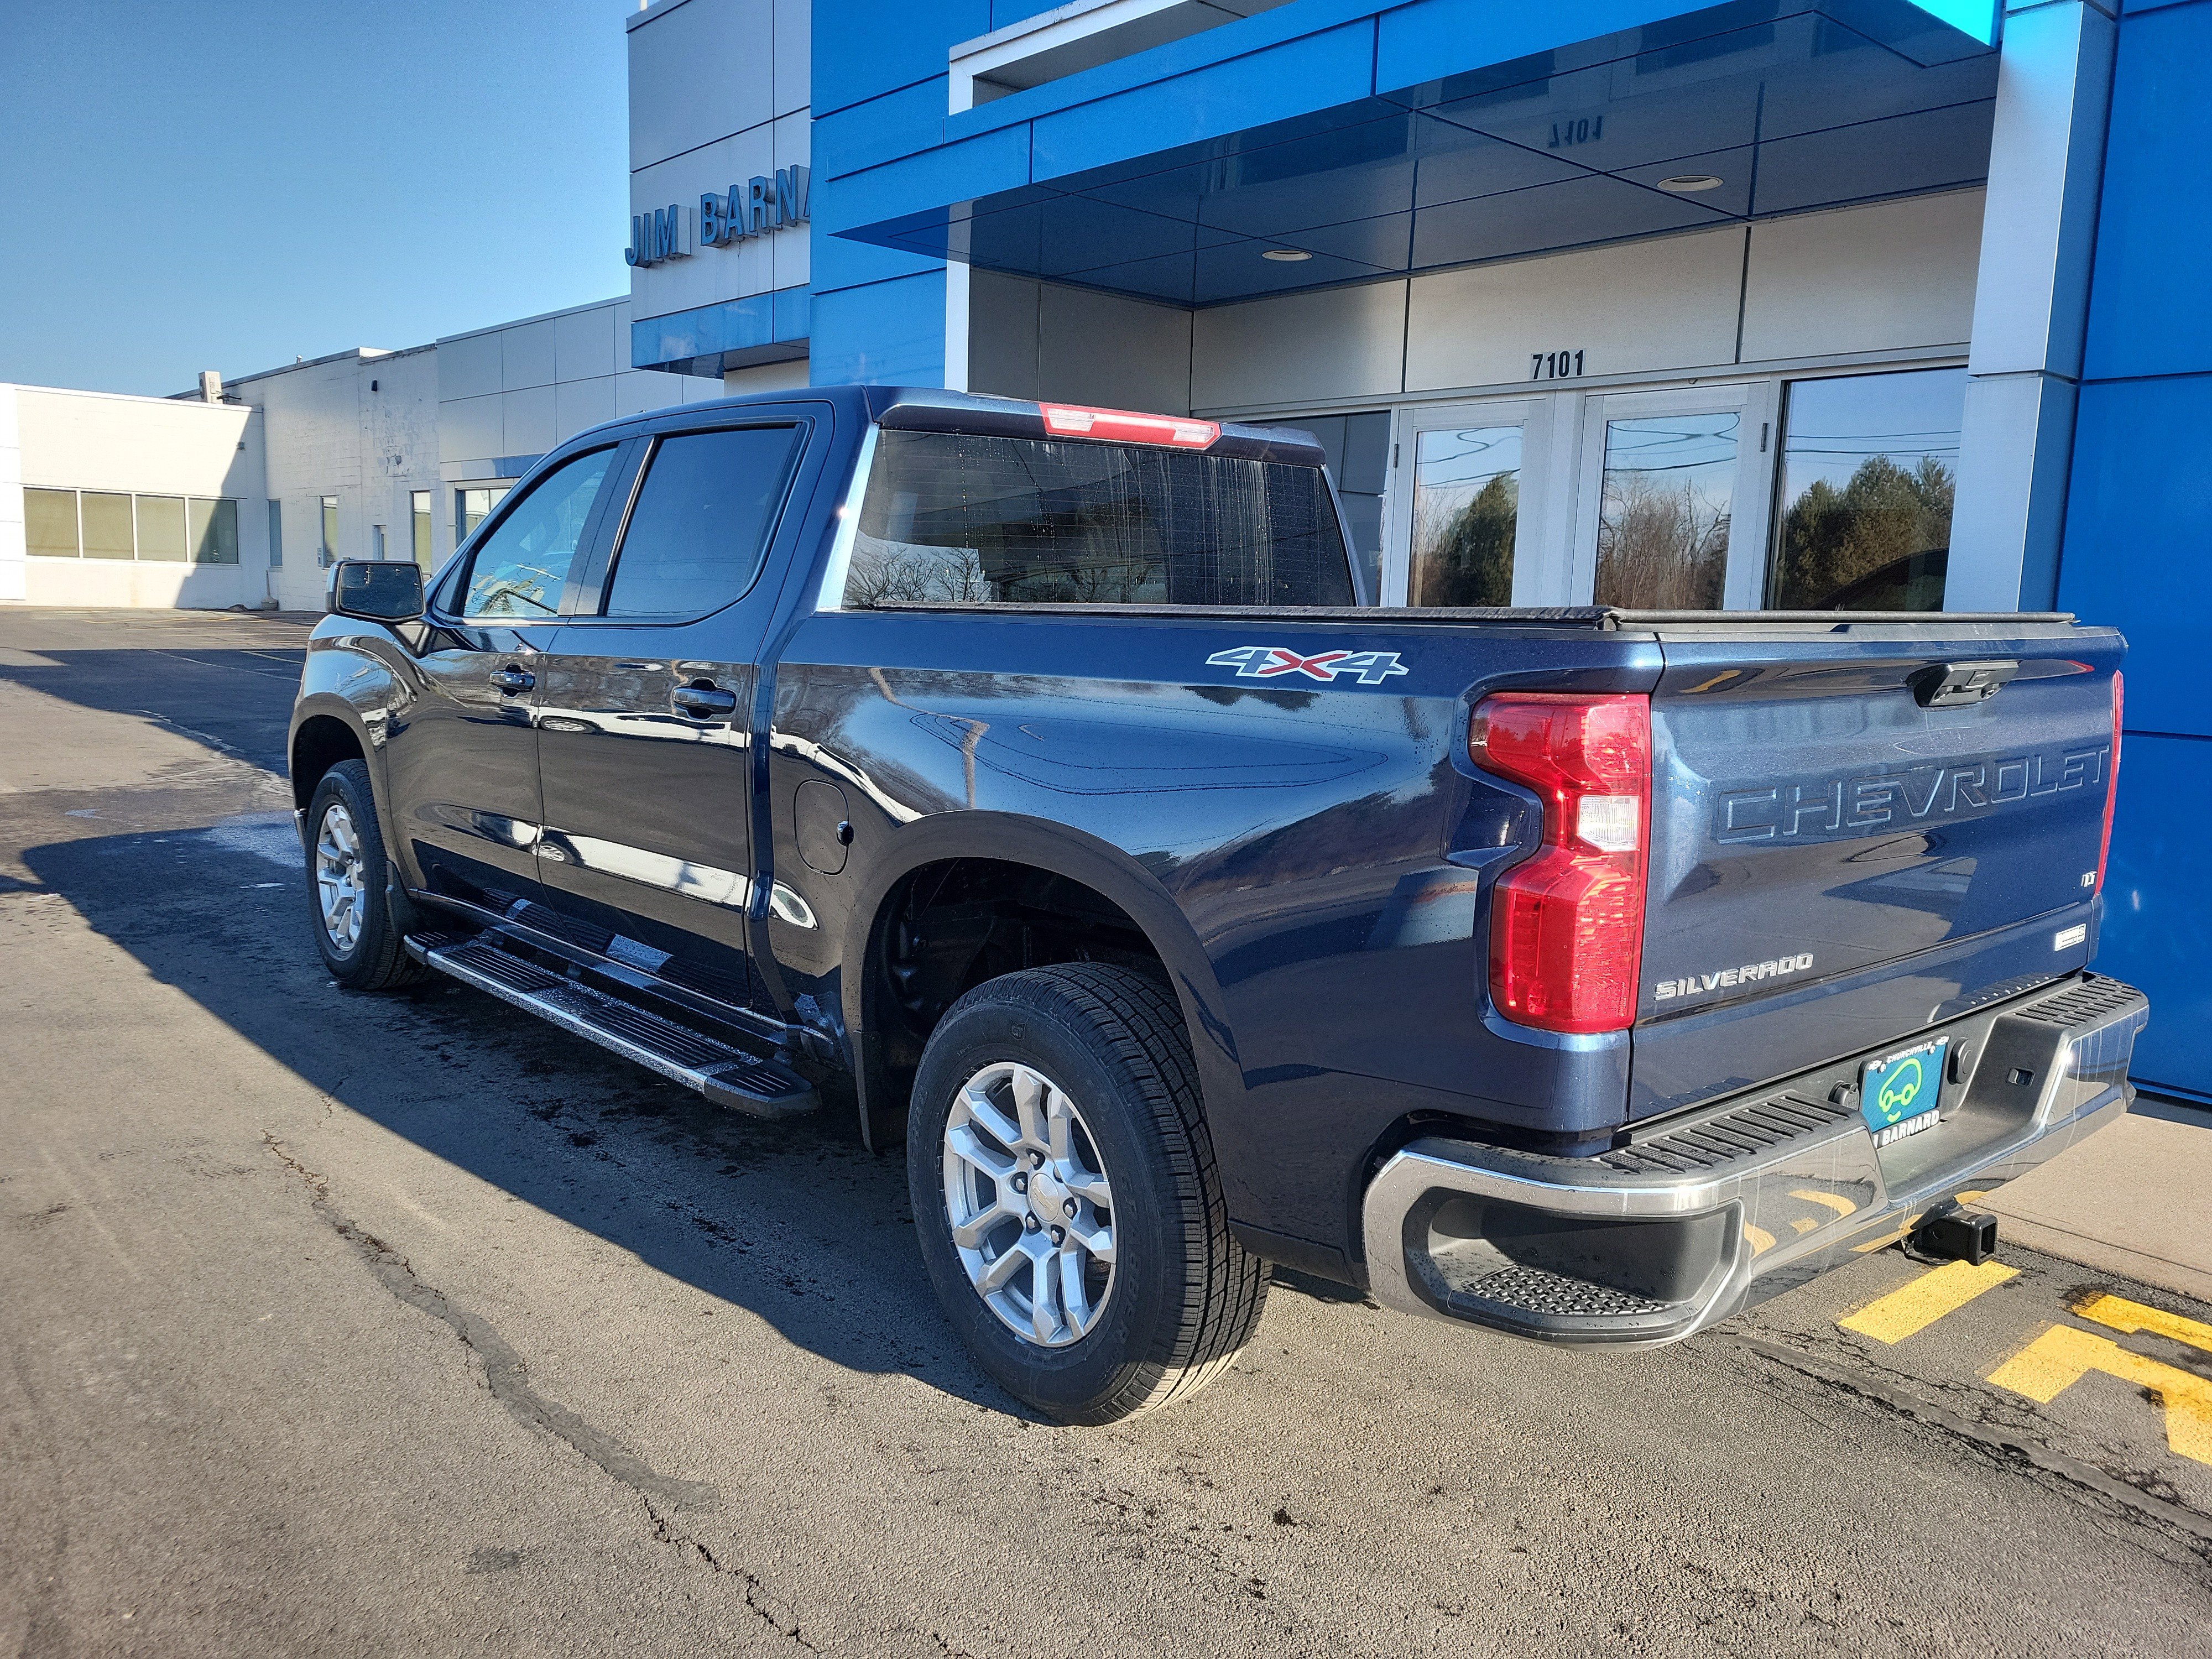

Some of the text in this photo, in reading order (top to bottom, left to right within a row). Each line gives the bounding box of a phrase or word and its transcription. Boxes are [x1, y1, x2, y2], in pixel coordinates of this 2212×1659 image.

[624, 164, 810, 267] JIM BARN
[1532, 349, 1584, 380] 7101
[1717, 743, 2111, 844] CHEVROLET
[1653, 952, 1814, 1001] SILVERADO
[1886, 1041, 1933, 1064] CHURCHVILLE
[1882, 1109, 1940, 1146] BARNARD
